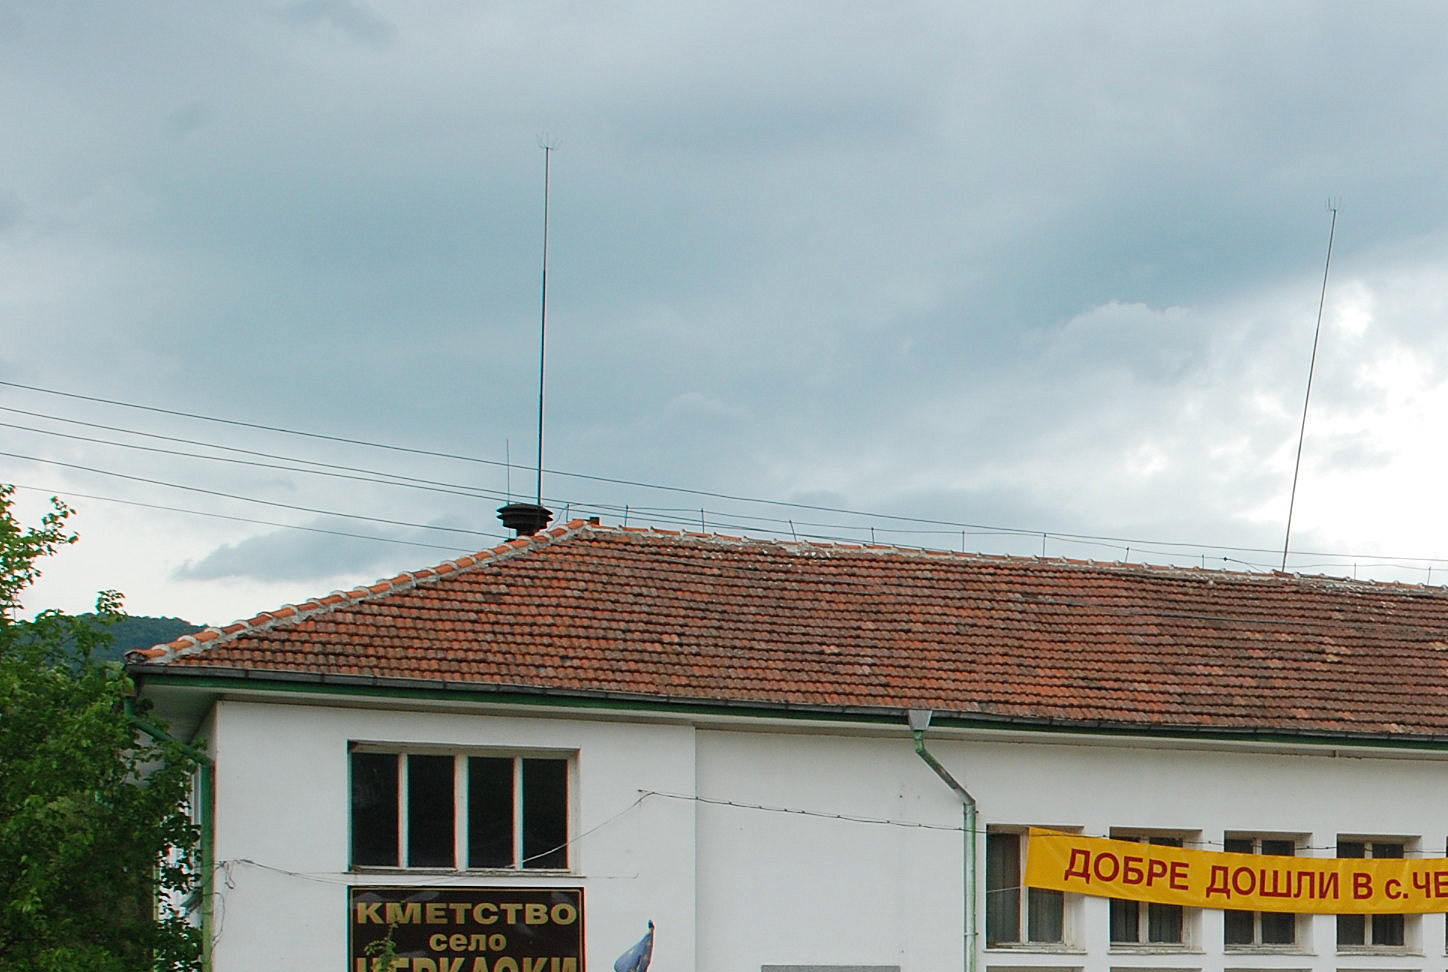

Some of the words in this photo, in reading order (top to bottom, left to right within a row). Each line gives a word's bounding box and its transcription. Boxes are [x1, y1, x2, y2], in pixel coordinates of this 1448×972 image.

[1064, 848, 1189, 891] ДОБРЕ
[1206, 865, 1339, 900] ДОШЛИ
[1353, 873, 1373, 899] В
[356, 902, 577, 925] КМЕТСТВО
[429, 933, 507, 951] село
